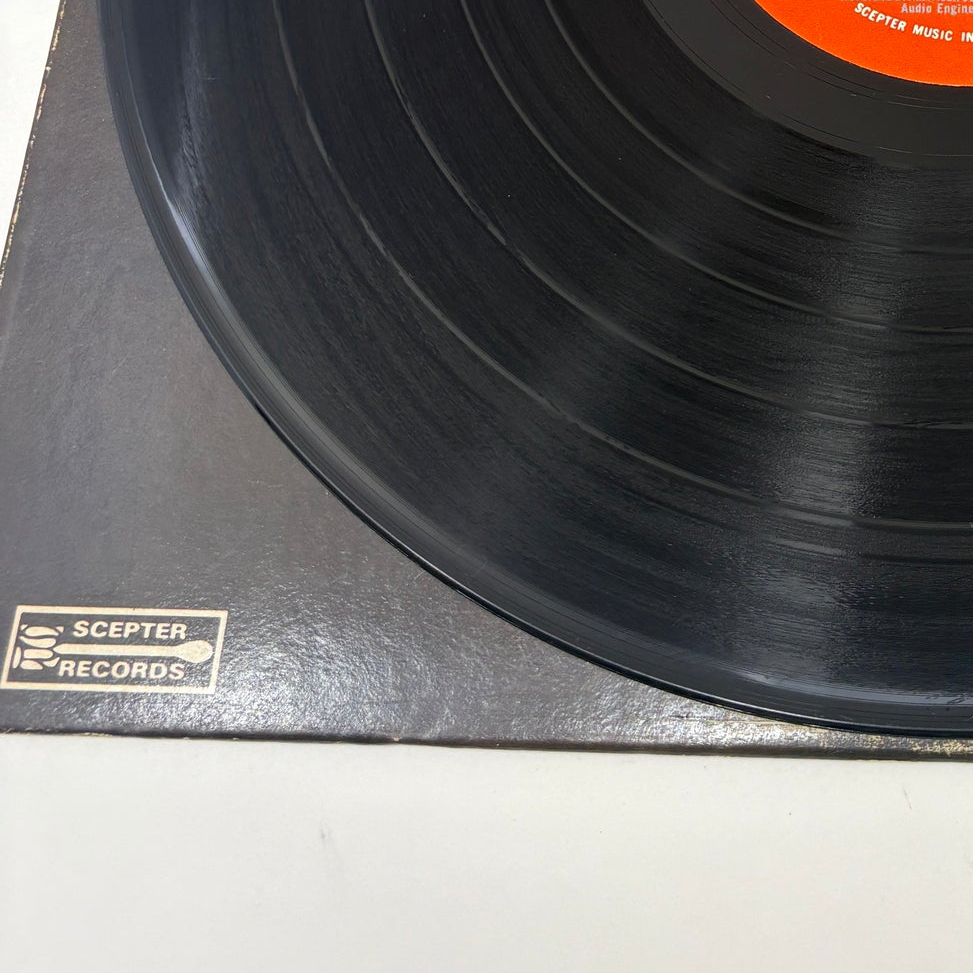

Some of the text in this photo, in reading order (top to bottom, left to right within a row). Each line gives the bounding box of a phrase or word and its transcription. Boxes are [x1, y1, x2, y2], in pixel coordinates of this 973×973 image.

[901, 3, 932, 14] Audio
[854, 2, 907, 32] SCEPTER
[912, 24, 953, 41] MUSIC
[72, 620, 188, 640] SCEPTER
[58, 660, 185, 680] RECORDS
